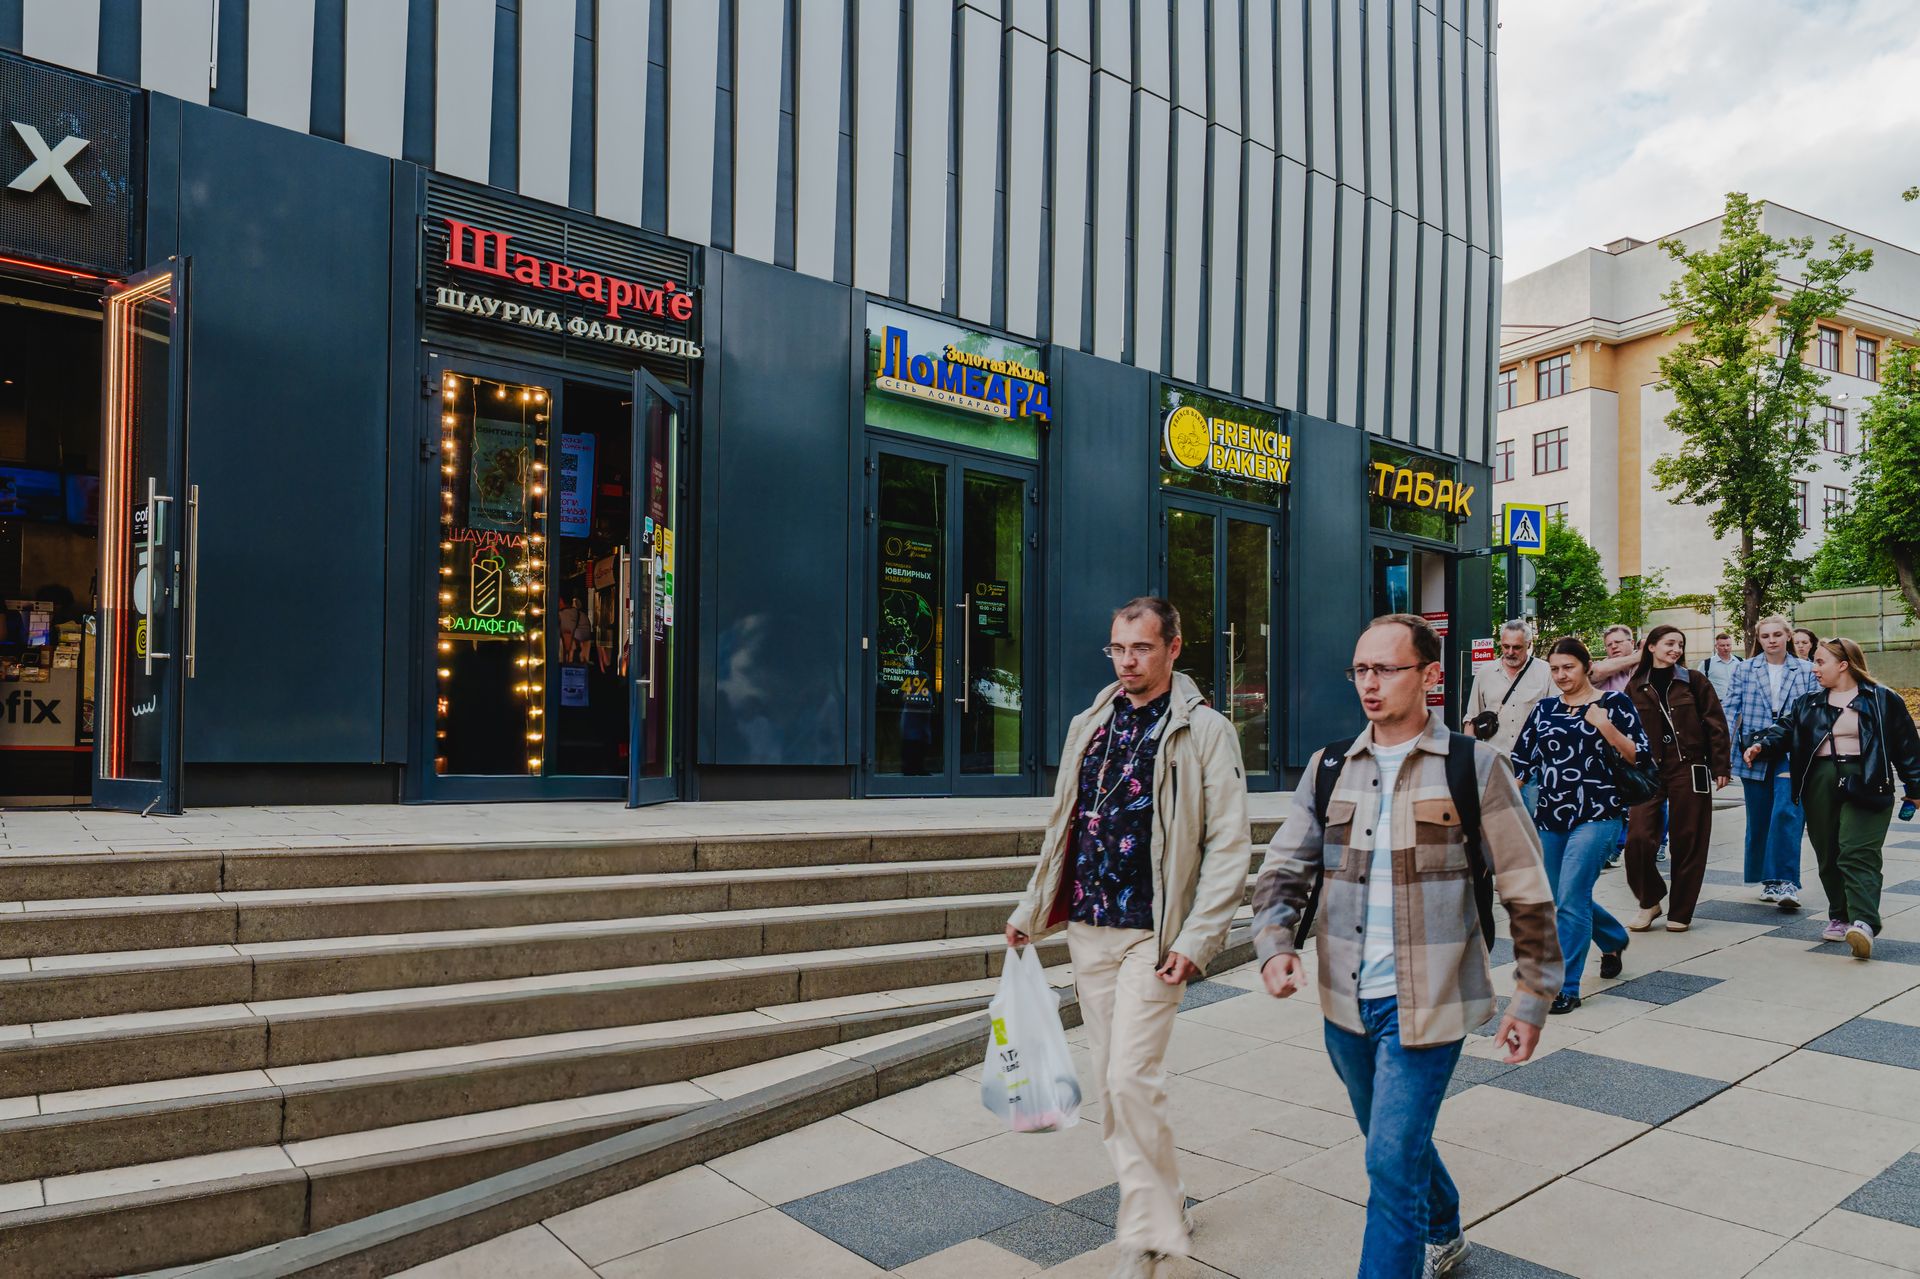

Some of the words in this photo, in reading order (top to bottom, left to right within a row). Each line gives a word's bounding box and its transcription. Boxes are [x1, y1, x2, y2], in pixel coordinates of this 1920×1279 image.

[436, 286, 564, 332] ШАУРМА
[566, 315, 702, 359] ФАЛАФЕЛЬ
[885, 379, 918, 394] СЕТЬ
[928, 390, 1009, 416] ЛОМБАРДОВ
[1212, 417, 1292, 459] FRENCH
[1212, 444, 1291, 483] BAKERY
[1373, 461, 1475, 517] ТАБАК
[450, 527, 523, 549] ШАУРМА
[885, 566, 932, 580] ЮВЕЛИРНЫХ
[1474, 651, 1491, 659] Вейп
[882, 674, 904, 682] СТАВКА
[883, 667, 920, 676] ПРОЦЕНТНАЯ
[901, 677, 930, 697] 4%
[0, 689, 61, 724] fix
